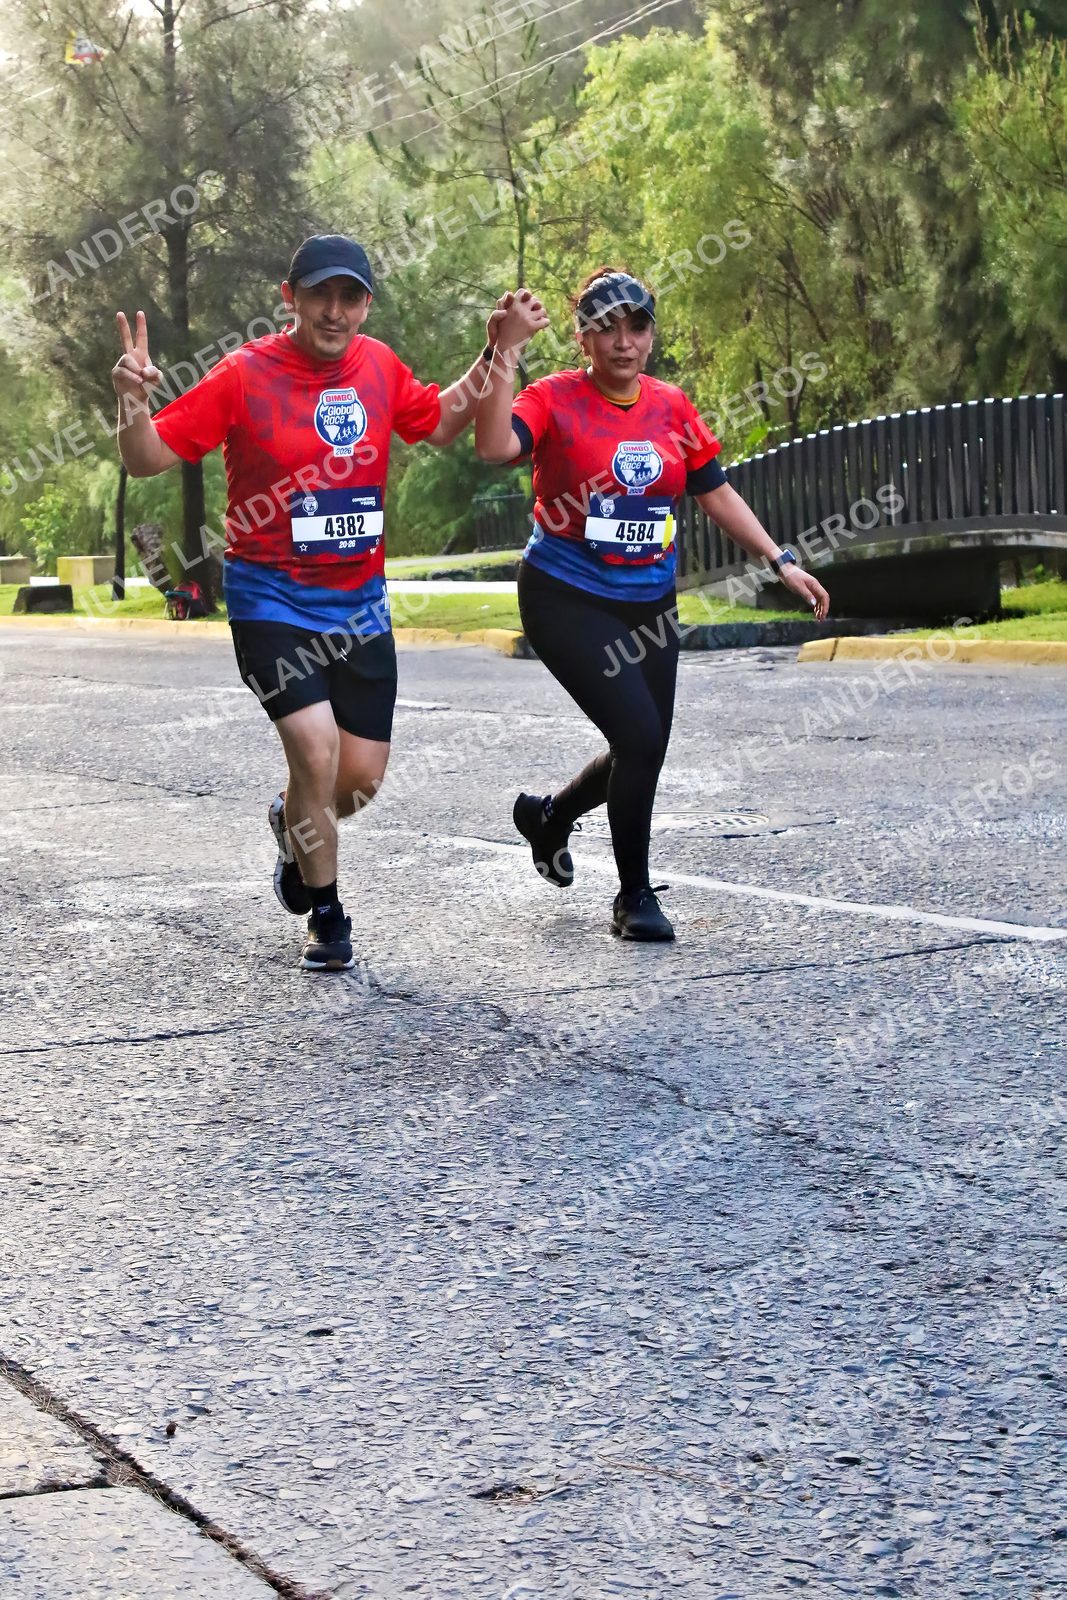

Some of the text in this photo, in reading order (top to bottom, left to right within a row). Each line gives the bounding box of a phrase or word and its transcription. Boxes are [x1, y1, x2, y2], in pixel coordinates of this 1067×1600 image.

[325, 393, 353, 402] BIMBO
[327, 404, 354, 416] Global
[323, 415, 346, 425] Race
[335, 447, 352, 456] 2026
[625, 453, 650, 463] Global
[620, 462, 642, 470] Race
[324, 514, 366, 538] 4382
[615, 521, 656, 542] 4584
[338, 540, 357, 549] 20-26
[625, 545, 642, 553] 20-26
